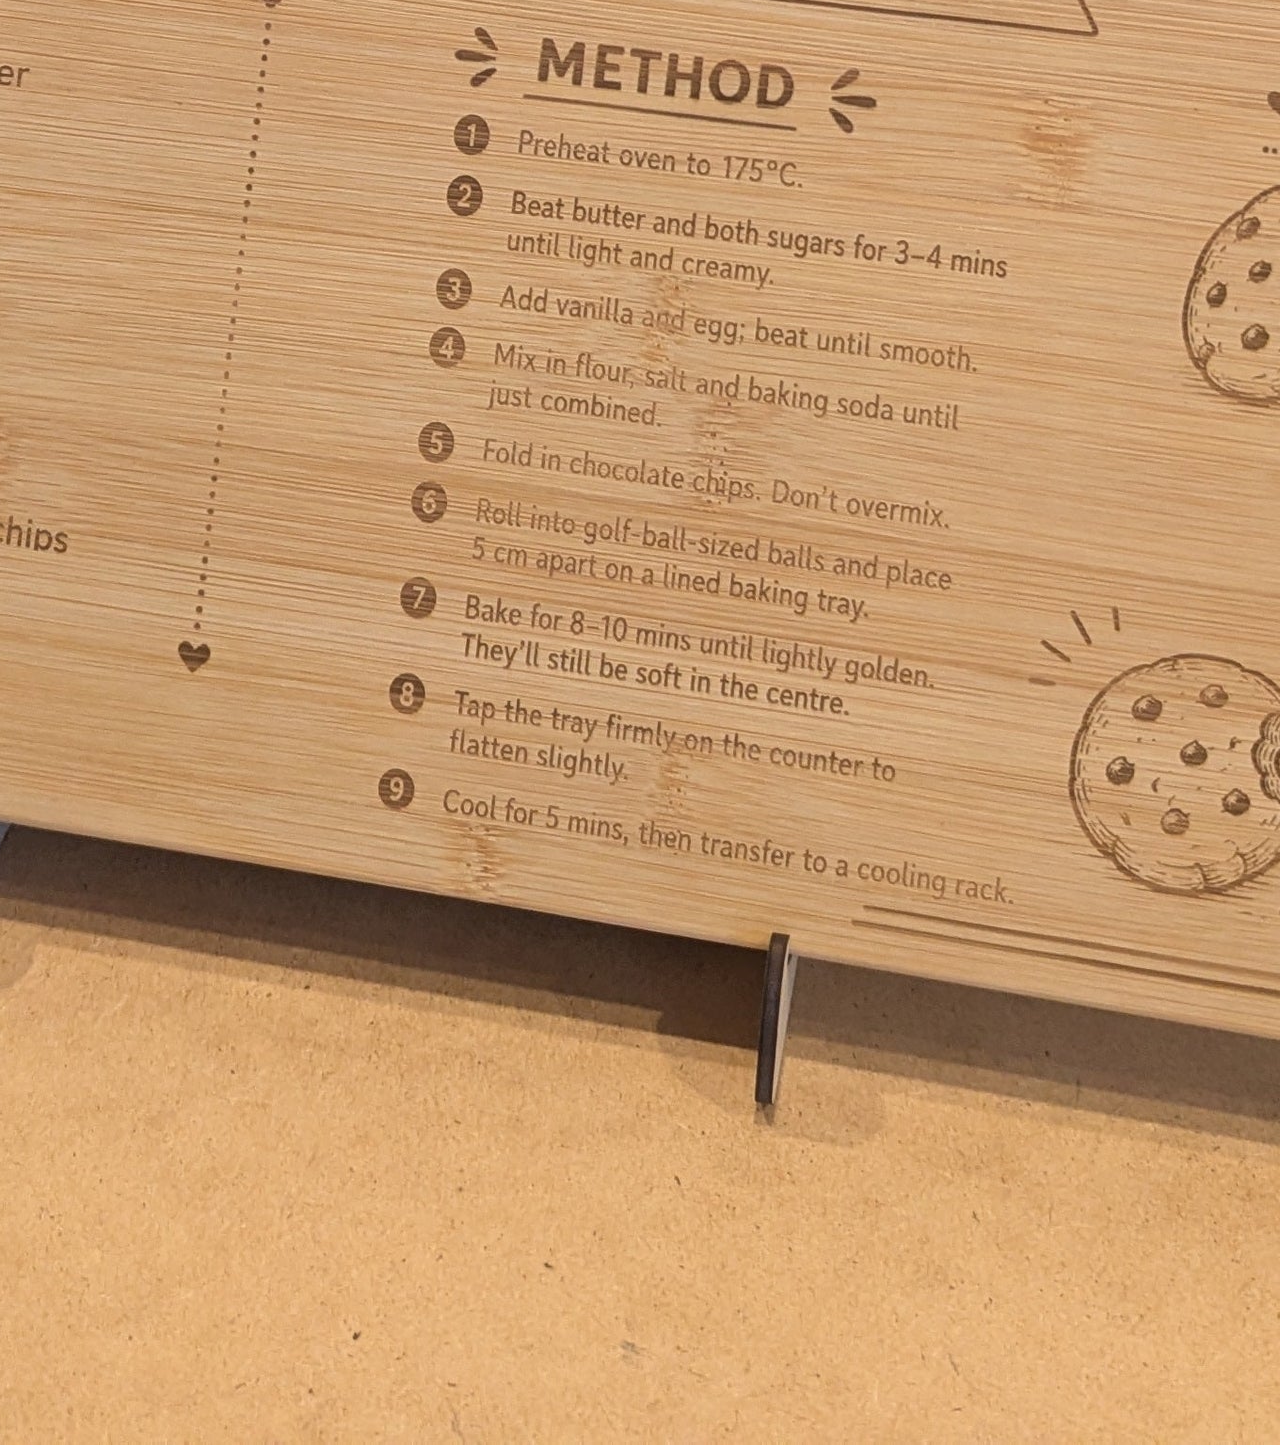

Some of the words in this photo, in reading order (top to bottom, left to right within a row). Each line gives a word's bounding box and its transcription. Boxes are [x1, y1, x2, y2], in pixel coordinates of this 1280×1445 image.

[537, 38, 795, 108] METHOD
[518, 130, 611, 165] Preheat
[619, 149, 675, 173] oven
[687, 154, 711, 177] to
[722, 156, 803, 189] 175°C.
[507, 230, 563, 256] until
[568, 235, 622, 267] light
[630, 246, 673, 272] and
[681, 254, 774, 290] creamy.
[510, 191, 566, 220] Beat
[572, 198, 646, 230] butter
[653, 211, 696, 238] and
[704, 216, 759, 244] both
[767, 229, 845, 259] sugars
[853, 233, 887, 262] for
[949, 250, 1008, 278] mins
[499, 285, 548, 314] Add
[555, 294, 633, 325] vanilla
[641, 307, 685, 334] and
[694, 318, 746, 345] egg;
[754, 318, 808, 348] beat
[816, 330, 872, 358] until
[878, 341, 978, 373] smooth.
[486, 379, 532, 411] just
[540, 389, 662, 427] combined.
[494, 343, 539, 372] Mix
[546, 350, 568, 375] in
[574, 354, 634, 388] flour,
[644, 366, 688, 393] salt
[695, 372, 741, 400] and
[747, 377, 830, 418] baking
[836, 394, 894, 422] soda
[902, 403, 959, 430] until
[482, 438, 532, 468] Fold
[540, 447, 562, 471] in
[569, 450, 685, 491] chocolate
[693, 470, 762, 503] chips.
[846, 497, 950, 529] overmix.
[472, 538, 485, 562] 5
[493, 547, 528, 568] cm
[536, 552, 597, 583] apart
[604, 562, 634, 583] on
[640, 568, 655, 585] a
[662, 565, 721, 596] lined
[729, 573, 809, 615] baking
[817, 588, 870, 624] tray.
[475, 498, 521, 529] Roll
[531, 505, 576, 534] into
[584, 515, 760, 562] golf-ball-sized
[767, 540, 825, 571] balls
[833, 552, 878, 580] and
[885, 558, 953, 592] place
[464, 595, 523, 627] Bake
[529, 602, 562, 629] for
[634, 624, 691, 651] mins
[700, 633, 754, 661] until
[761, 640, 838, 680] lightly
[844, 655, 935, 690] golden.
[548, 646, 593, 675] still
[599, 655, 628, 680] be
[635, 661, 682, 689] soft
[690, 667, 712, 692] in
[720, 671, 759, 700] the
[766, 684, 850, 716] centre.
[450, 730, 529, 763] flatten
[536, 742, 629, 785] slightly.
[455, 691, 496, 726] Tap
[504, 697, 544, 727] the
[550, 704, 598, 741] tray
[604, 713, 676, 751] firmly
[684, 731, 715, 755] on
[722, 732, 762, 762] the
[769, 744, 865, 777] counter
[870, 757, 896, 783] to
[443, 790, 498, 822] Cool
[504, 798, 539, 826] for
[545, 805, 560, 830] 5
[566, 809, 630, 845] mins,
[639, 820, 692, 850] then
[700, 831, 796, 868] transfer
[802, 848, 828, 873] to
[835, 858, 849, 877] a
[856, 860, 948, 898] cooling
[954, 874, 1014, 904] rack.
